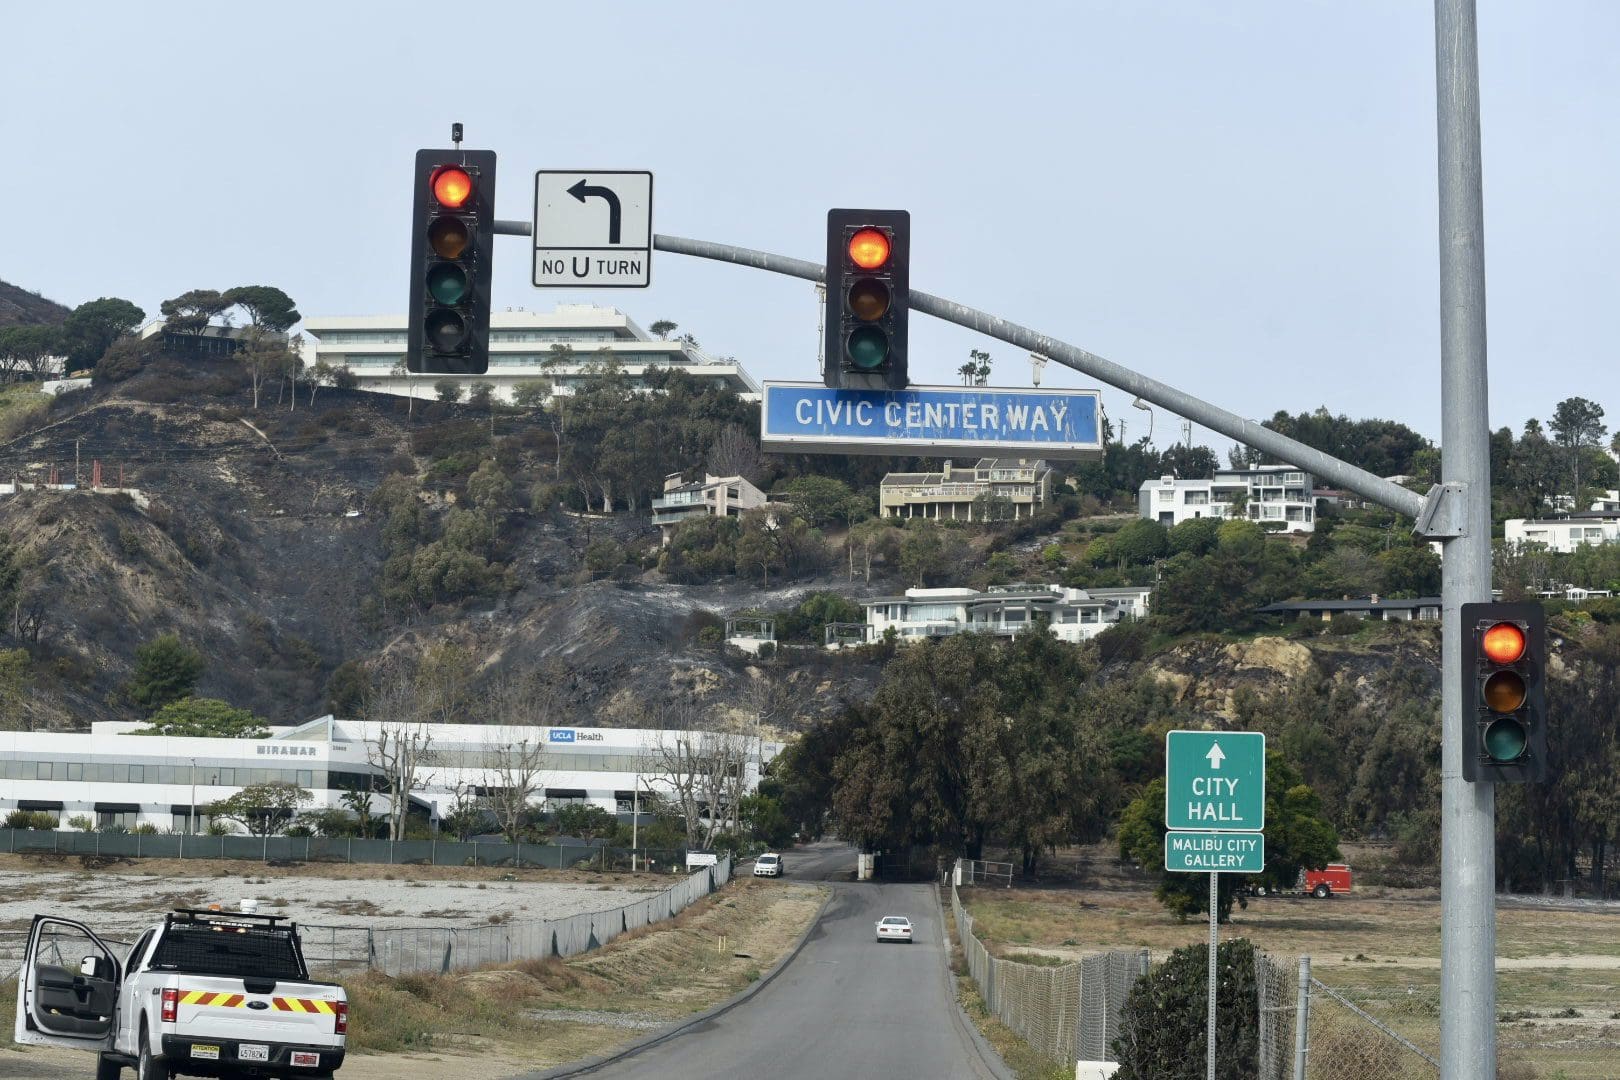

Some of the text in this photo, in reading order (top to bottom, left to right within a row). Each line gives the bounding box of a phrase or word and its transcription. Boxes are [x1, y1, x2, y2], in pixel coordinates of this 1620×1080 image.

[542, 256, 641, 278] NO U TURN
[795, 398, 1068, 432] CIVIC CENTER WAY
[552, 731, 604, 741] UCLA Health
[256, 745, 317, 756] MIRAMAR
[1192, 777, 1239, 796] CITY
[1188, 802, 1243, 821] HALL
[1173, 838, 1257, 852] MALIBU CITY
[1184, 854, 1245, 867] GALLERY
